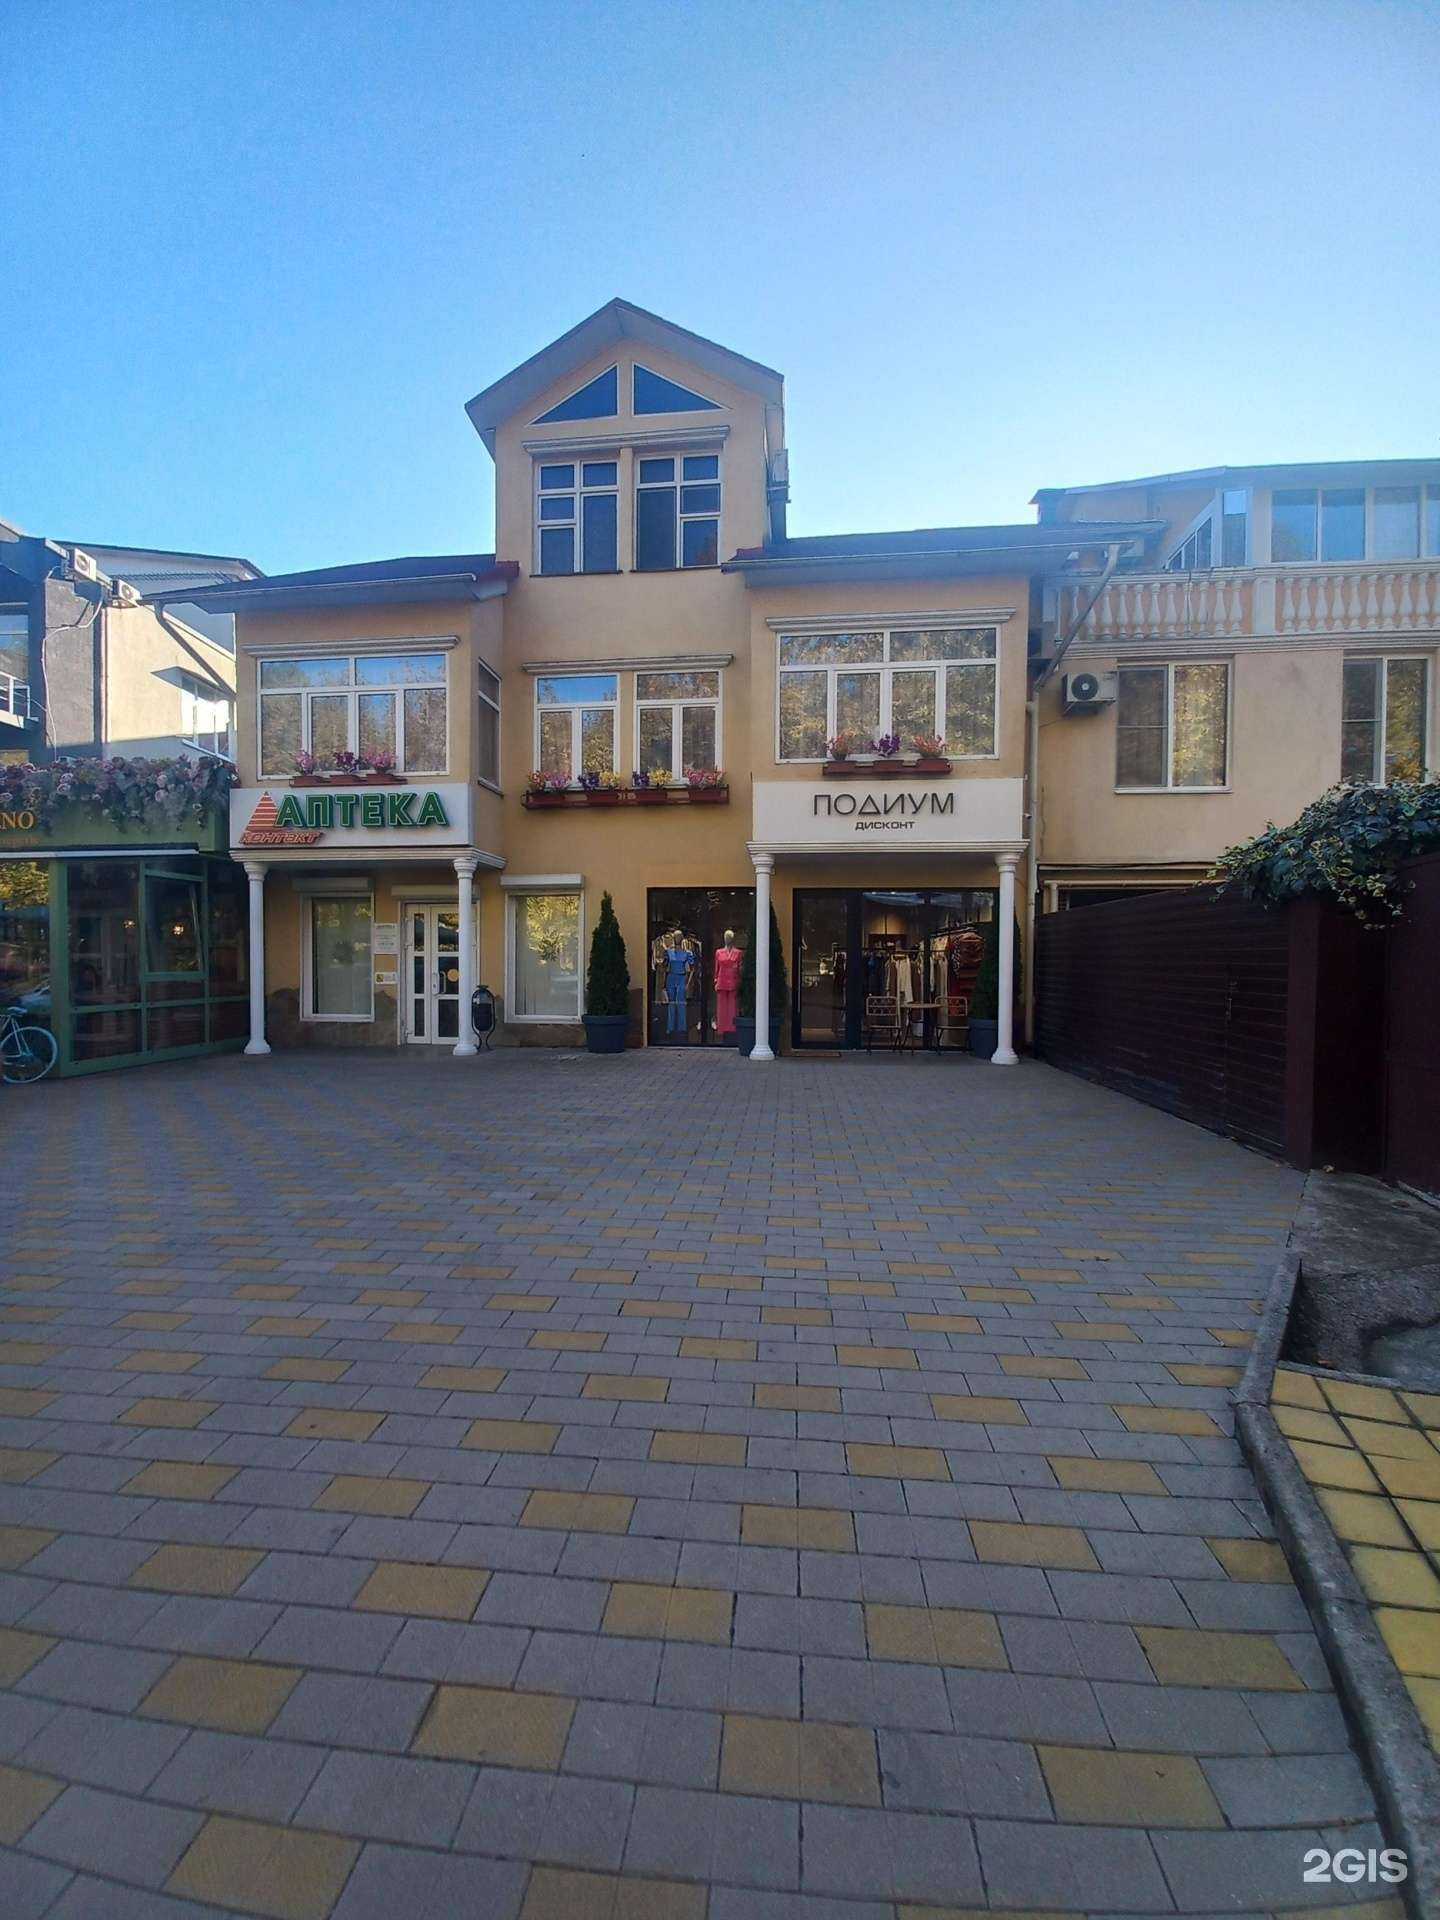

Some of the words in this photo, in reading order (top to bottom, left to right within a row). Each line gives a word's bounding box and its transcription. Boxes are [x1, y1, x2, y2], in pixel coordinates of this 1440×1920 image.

[274, 791, 449, 829] АПТЕКА
[813, 793, 954, 816] ПОДИУМ
[855, 821, 915, 831] ДИСКОНТ
